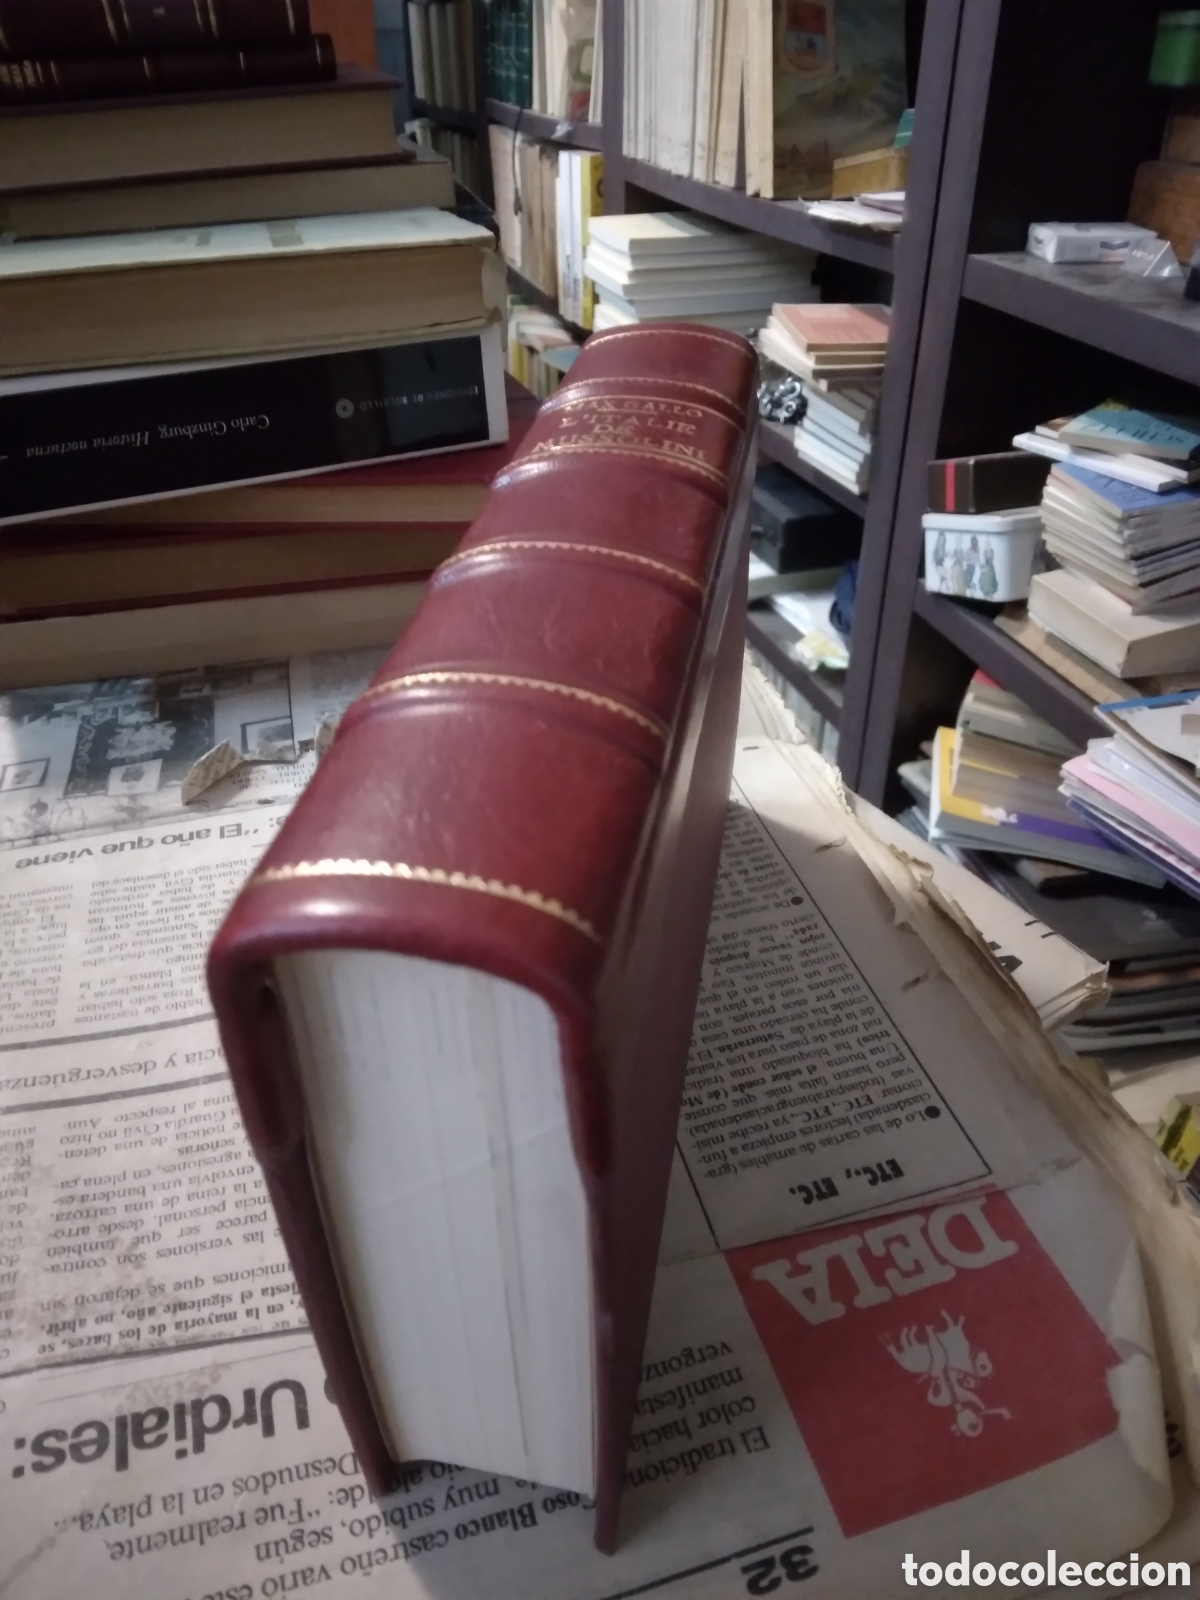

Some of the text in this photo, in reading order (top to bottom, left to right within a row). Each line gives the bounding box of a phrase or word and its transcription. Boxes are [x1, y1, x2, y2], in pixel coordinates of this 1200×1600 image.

[25, 413, 270, 459] Carlo Ginzburg Historia nocturna
[101, 836, 154, 854] que
[160, 828, 211, 847] año
[15, 847, 94, 869] viene
[778, 953, 794, 964] de
[725, 957, 776, 981] Motrico
[700, 995, 869, 1044] conde ha cercado una casa
[844, 1011, 858, 1021] la
[858, 1006, 877, 1018] de
[807, 1014, 843, 1030] playa
[861, 1017, 883, 1032] nal
[790, 1025, 805, 1036] de
[829, 1024, 859, 1038] zona
[779, 1035, 810, 1051] paso
[811, 1033, 829, 1045] de
[833, 1041, 852, 1051] ha
[697, 1049, 713, 1061] El
[747, 1044, 777, 1059] para
[868, 1042, 900, 1056] Una
[164, 1052, 177, 1068] y
[726, 1053, 747, 1065] los
[761, 1047, 831, 1071] bloqueado
[875, 1051, 907, 1069] pero
[729, 1066, 756, 1078] una
[771, 1068, 803, 1082] señor
[805, 1064, 819, 1076] el
[832, 1064, 873, 1081] hacen
[890, 1067, 914, 1079] vas
[682, 1074, 724, 1092] tradic
[731, 1077, 766, 1094] conde
[797, 1076, 829, 1089] falta
[706, 1087, 730, 1103] (de
[731, 1093, 757, 1108] que
[832, 1094, 874, 1112] ETC.,
[772, 1114, 790, 1127] ya
[799, 1116, 853, 1137] lectores
[885, 1117, 903, 1129] de
[59, 1110, 226, 1148] Guardia Civil no hizo
[175, 1124, 225, 1142] noticia
[728, 1121, 770, 1140] recibe
[862, 1123, 885, 1135] las
[114, 1139, 144, 1151] una
[150, 1136, 168, 1147] de
[740, 1130, 797, 1152] empieza
[818, 1129, 861, 1147] cartas
[729, 1147, 739, 1155] a
[798, 1141, 818, 1155] de
[698, 1149, 728, 1164] fun-
[738, 1147, 797, 1169] amables
[83, 1171, 127, 1187] plena
[133, 1168, 151, 1180] en
[789, 1158, 904, 1205] ETC., ETC.
[153, 1179, 182, 1191] una
[233, 1182, 246, 1194] la
[81, 1185, 146, 1204] bandera
[161, 1195, 180, 1209] de
[187, 1186, 226, 1202] reina
[124, 1200, 154, 1213] una
[98, 1218, 144, 1235] desde
[216, 1210, 268, 1230] parece
[131, 1231, 162, 1247] que
[178, 1225, 201, 1238] ser
[44, 1230, 264, 1273] las versiones son contra-
[751, 1195, 1019, 1326] DEIA
[173, 1275, 205, 1292] que
[74, 1287, 141, 1309] dejaron
[163, 1293, 233, 1316] siguiente
[240, 1290, 253, 1305] el
[121, 1305, 156, 1321] año,
[245, 1307, 260, 1320] la
[266, 1303, 284, 1314] en
[94, 1312, 115, 1325] no
[174, 1311, 237, 1332] mayoría
[118, 1327, 141, 1341] los
[148, 1323, 167, 1337] de
[38, 1343, 55, 1354] se
[61, 1333, 112, 1349] bares,
[12, 1379, 310, 1479] Urdiales:
[631, 1395, 756, 1455] color hacia
[624, 1425, 771, 1487] El tradicion
[232, 1448, 360, 1496] Desnudos
[193, 1483, 224, 1505] en
[161, 1492, 185, 1516] la
[254, 1477, 500, 1565] muy subido, según
[454, 1501, 538, 1540] Blanco
[339, 1529, 449, 1577] castreño
[740, 1544, 819, 1596] 32
[260, 1564, 332, 1600] varió
